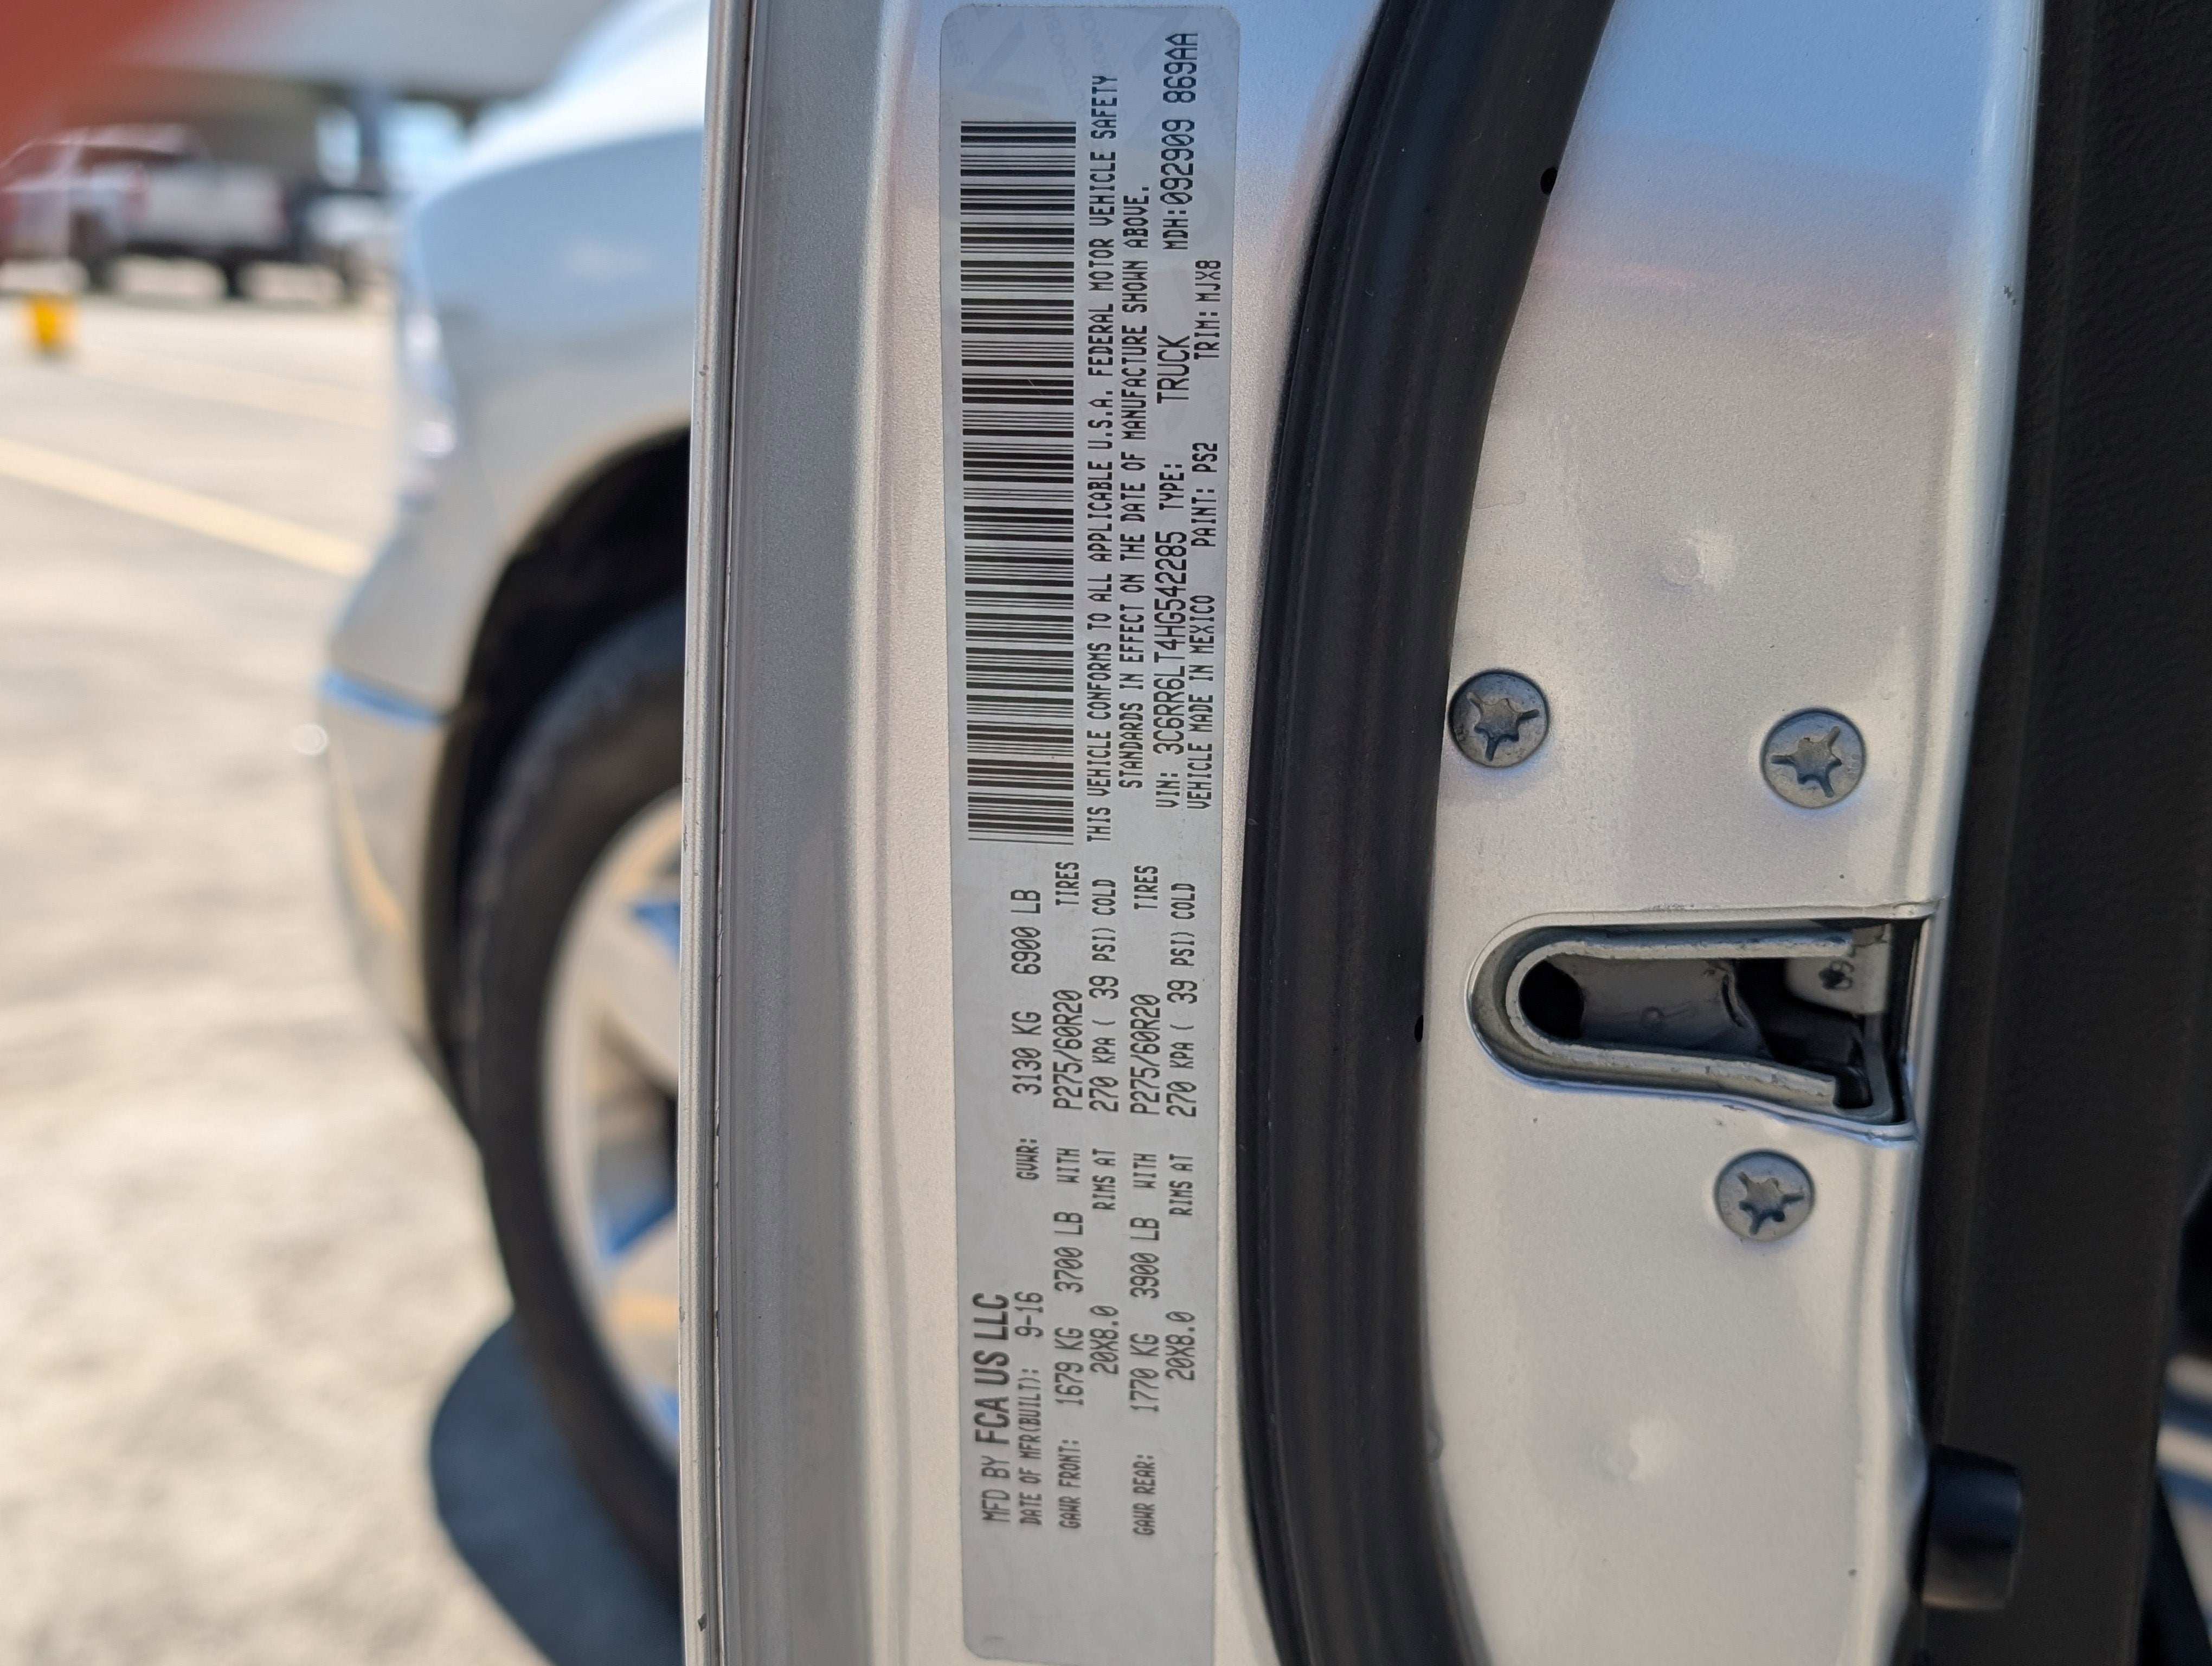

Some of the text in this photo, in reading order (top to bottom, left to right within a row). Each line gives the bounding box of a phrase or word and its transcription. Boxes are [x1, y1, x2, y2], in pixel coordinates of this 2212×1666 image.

[1163, 33, 1198, 103] 869AA
[1090, 76, 1117, 139] SAFETY
[1089, 151, 1116, 226] VEHICLE
[1088, 239, 1114, 291] MOTOR
[1195, 260, 1221, 302] MJX8
[1088, 303, 1114, 376] FEDERAL
[1193, 312, 1220, 360] TRIM:
[1156, 335, 1190, 404] TRUCK
[1088, 390, 1113, 450] U.S.A.
[1192, 443, 1218, 472] PS2
[1118, 187, 1149, 788] STANDARDS IN EFFECT ON THE DATE OF MANUFACTURE SHOWN ABOVE.
[1159, 464, 1185, 510] TYPE:
[1087, 461, 1113, 562] APPLICABLE
[1191, 489, 1217, 547] PAINT:
[1087, 573, 1112, 602] ALL
[1086, 613, 1112, 630] TO
[1189, 595, 1215, 654] MEXICO
[1086, 643, 1111, 720] CONFORMS
[1188, 665, 1214, 681] IN
[1188, 694, 1213, 732] MADE
[1086, 730, 1111, 797] VEHICLE
[1187, 742, 1212, 809] VEHICLE
[1156, 773, 1180, 808] VIN:
[1086, 807, 1111, 842] THIS
[1092, 879, 1116, 915] COLD
[1171, 883, 1195, 919] COLD
[1092, 927, 1116, 962] PSI)
[1170, 932, 1195, 966] PSI)
[1089, 976, 1118, 999] 39
[1167, 980, 1198, 1004] 39
[1011, 889, 1042, 1180] GVWR: 3130 KG 6900 LB
[1092, 1037, 1116, 1064] KPA
[1169, 1042, 1194, 1069] KPA
[1089, 1076, 1118, 1112] 270
[1166, 1081, 1197, 1117] 270
[1092, 1149, 1115, 1167] AT
[1169, 1154, 1193, 1171] AT
[1052, 862, 1084, 1529] GAWR FRONT: 1679 KG 3700 LB WITH P275/60R20 TIRES
[1092, 1175, 1116, 1210] RIMS
[1129, 866, 1160, 1536] GAWR REAR: 1770 KG 3900 LB WITH P275/60R20 TIRES
[1169, 1181, 1193, 1216] RIMS
[1089, 1305, 1118, 1375] 20X8.0
[1165, 1311, 1195, 1381] 20X8.0
[972, 1293, 1010, 1522] MFD BY FCA US LLC
[1014, 1292, 1043, 1525] DATE OF MFR(BUILT): 9-16
